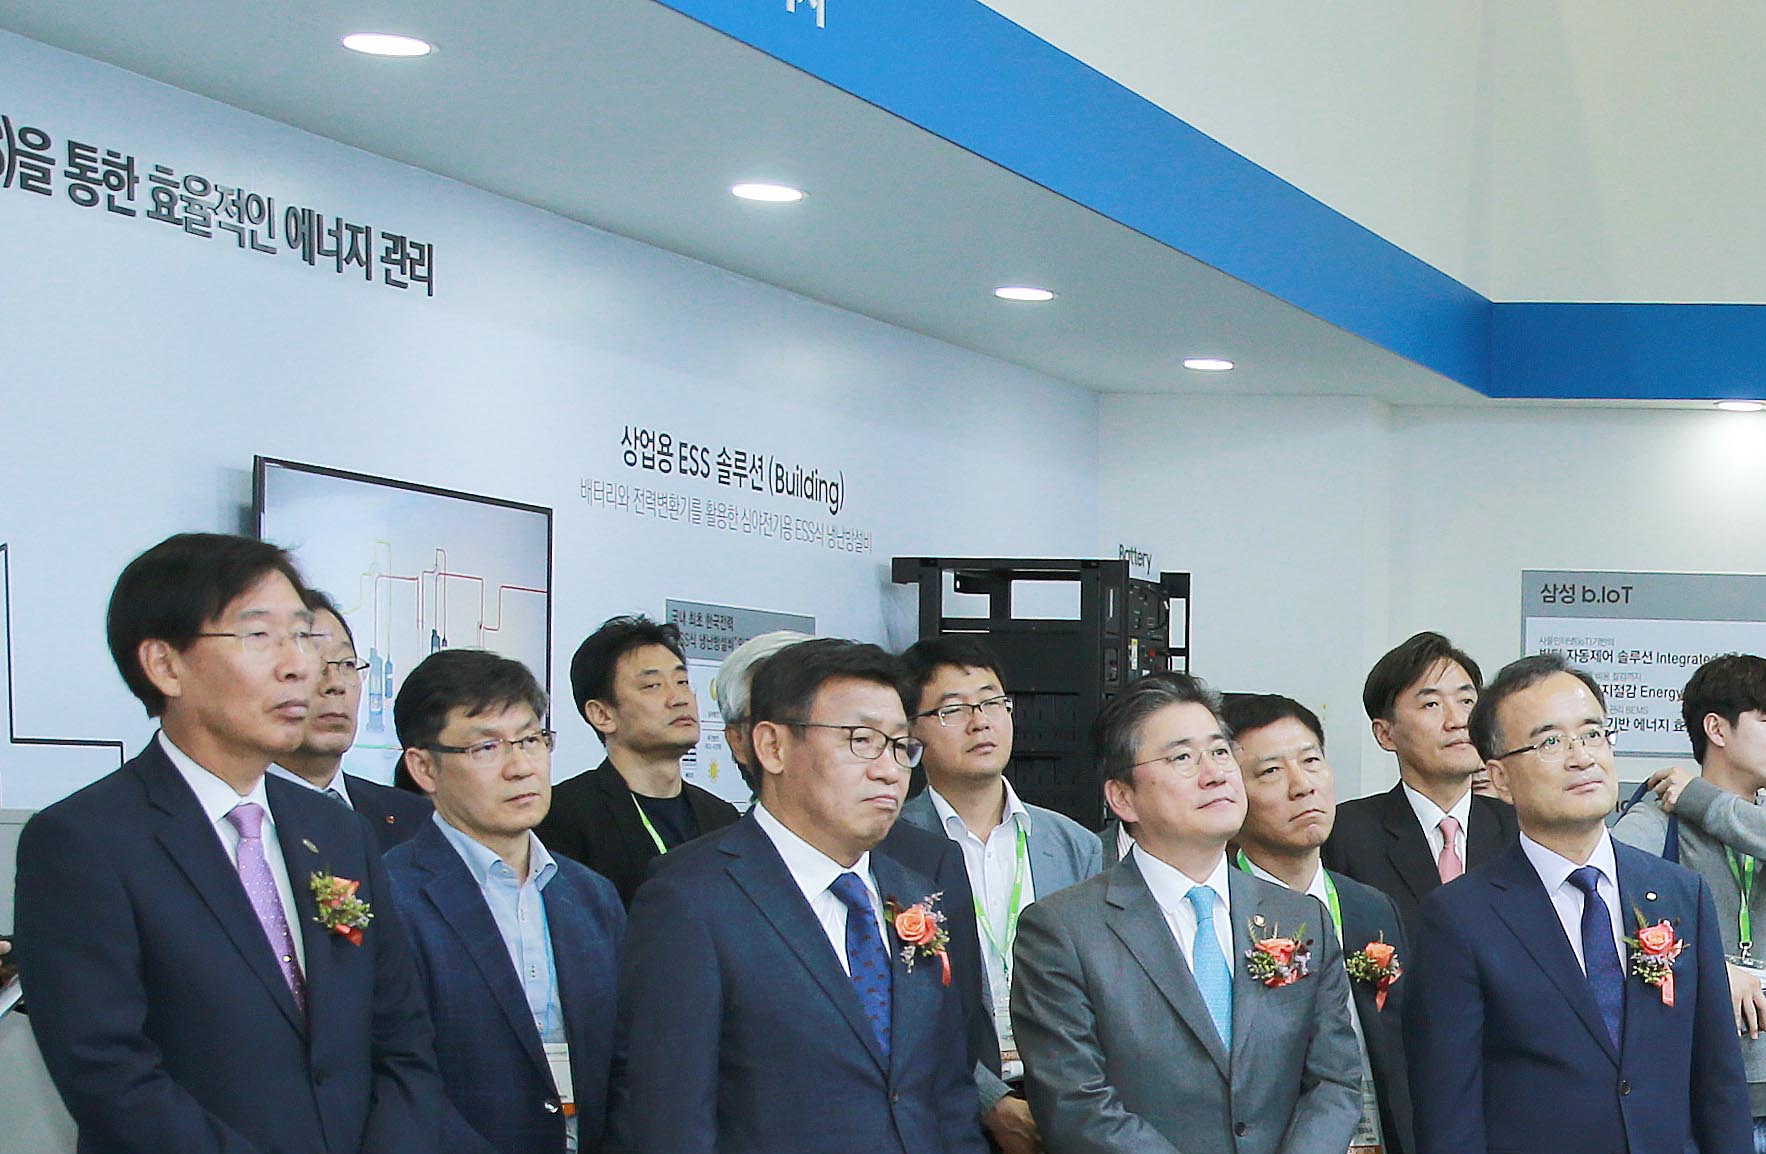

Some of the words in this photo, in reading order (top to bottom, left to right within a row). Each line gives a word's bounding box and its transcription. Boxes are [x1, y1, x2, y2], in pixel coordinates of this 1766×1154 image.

[0, 114, 56, 197] )을
[64, 139, 140, 217] 통한
[147, 164, 277, 254] 효율적인
[285, 206, 373, 281] 에너지
[380, 231, 434, 297] 관리
[621, 425, 674, 474] 상업용
[679, 441, 711, 479] ESS
[716, 446, 764, 492] 솔루션
[769, 455, 845, 516] (Building)
[580, 478, 630, 513] 배터리와
[633, 487, 702, 525] 전력변환기를
[705, 499, 739, 531] 활용한
[741, 508, 793, 542] 심야전기용
[826, 523, 873, 555] 냉난방설비
[1540, 583, 1576, 604] 삼성
[1582, 585, 1634, 605] b.IoT
[1566, 649, 1614, 664] 자동제어
[1618, 649, 1653, 664] 솔루션
[1597, 684, 1637, 698] 지절감
[1640, 685, 1684, 702] Energy
[1606, 717, 1630, 732] 기반
[1633, 717, 1670, 732] 에너지
